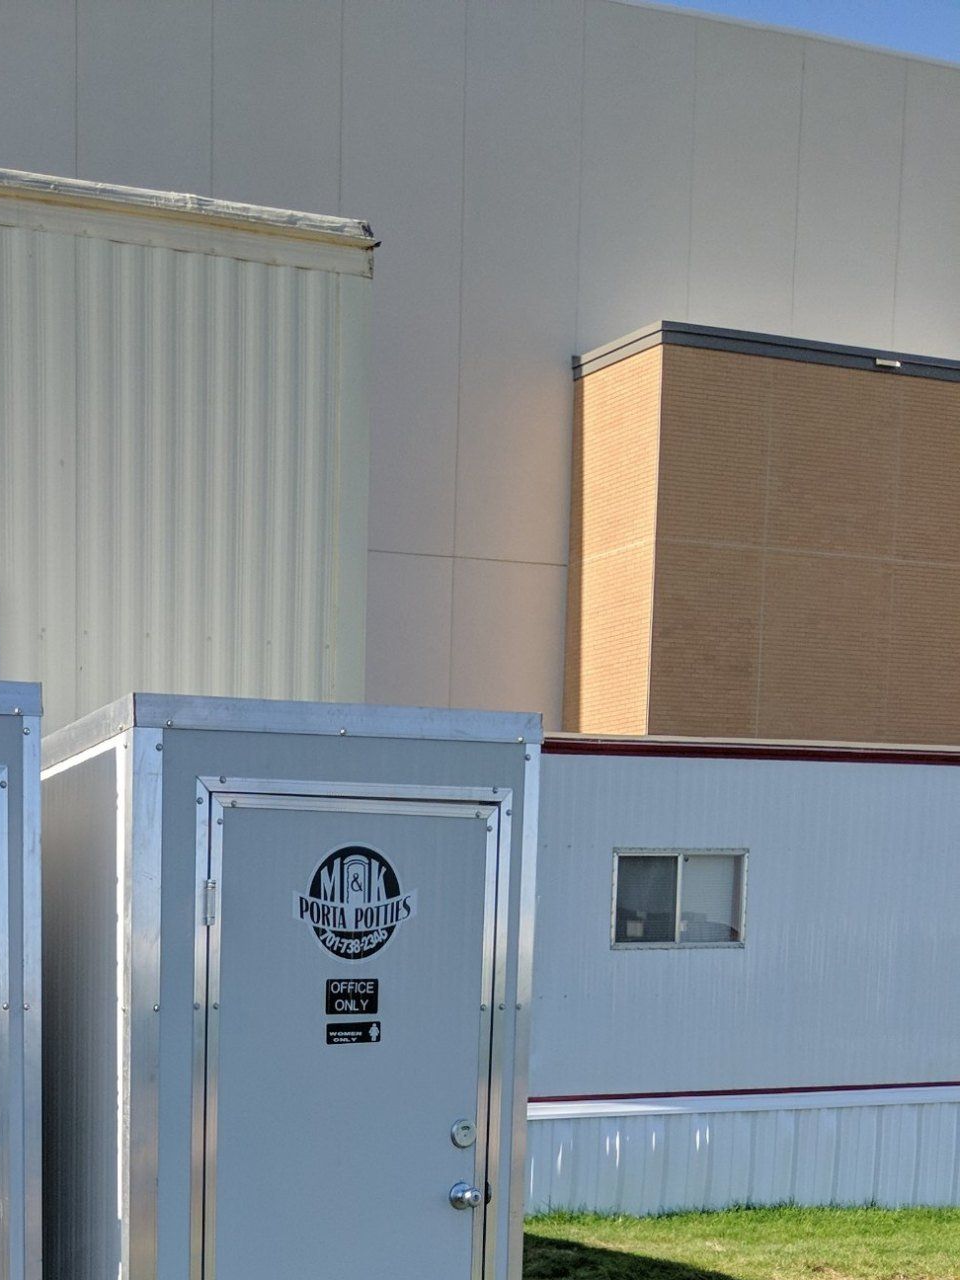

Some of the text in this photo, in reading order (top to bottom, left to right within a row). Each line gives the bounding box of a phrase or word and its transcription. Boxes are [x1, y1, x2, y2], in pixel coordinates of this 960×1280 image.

[299, 895, 411, 929] PORTA POTTIES
[319, 928, 389, 954] 701-738-2346
[330, 981, 375, 994] OFFICE
[334, 1000, 368, 1011] ONLY
